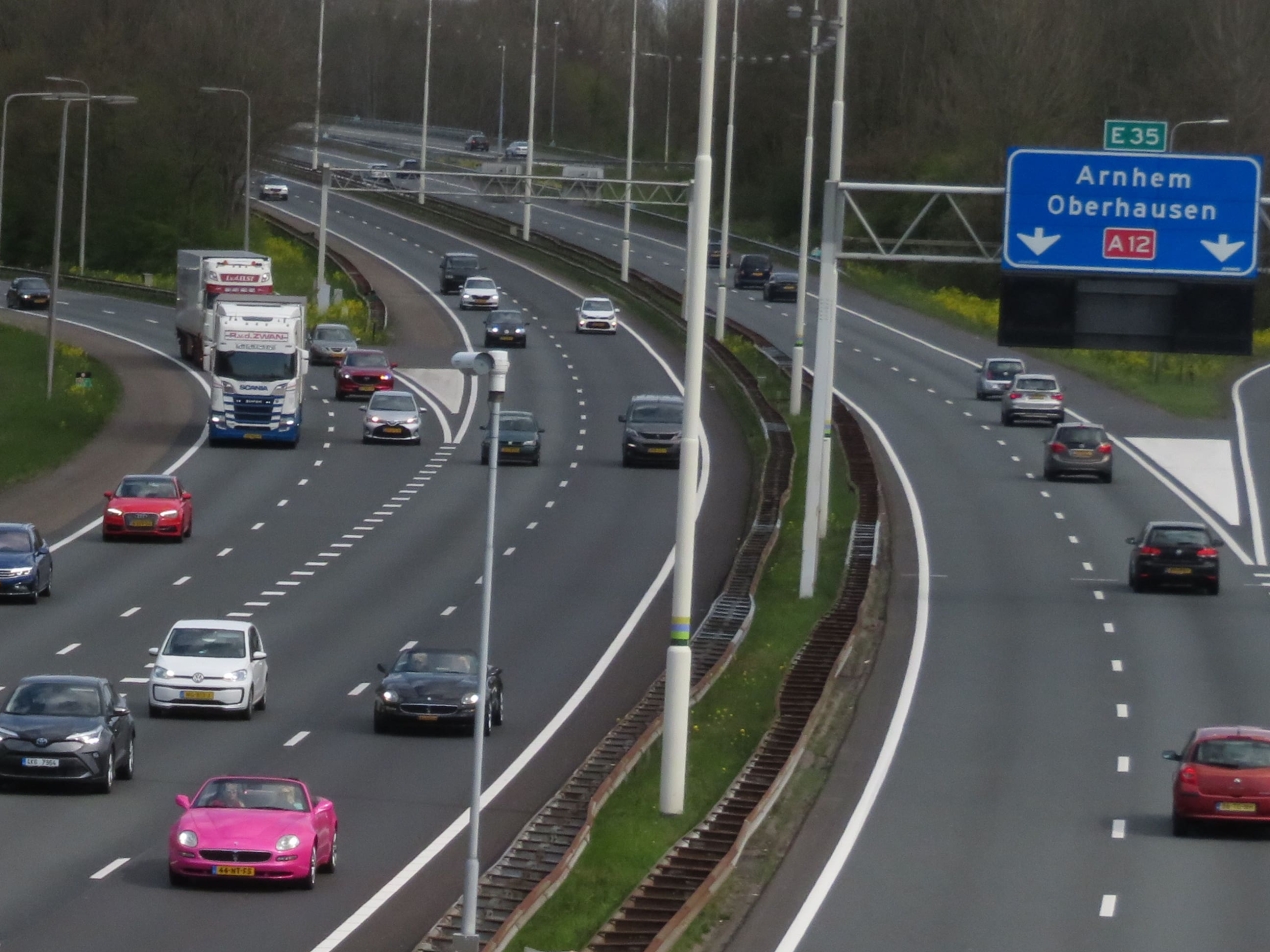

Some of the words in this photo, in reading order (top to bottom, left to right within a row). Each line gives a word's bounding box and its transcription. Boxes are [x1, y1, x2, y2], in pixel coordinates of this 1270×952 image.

[1130, 128, 1160, 145] 35
[1076, 165, 1191, 189] Arnhem
[1047, 194, 1217, 220] Oberhausen
